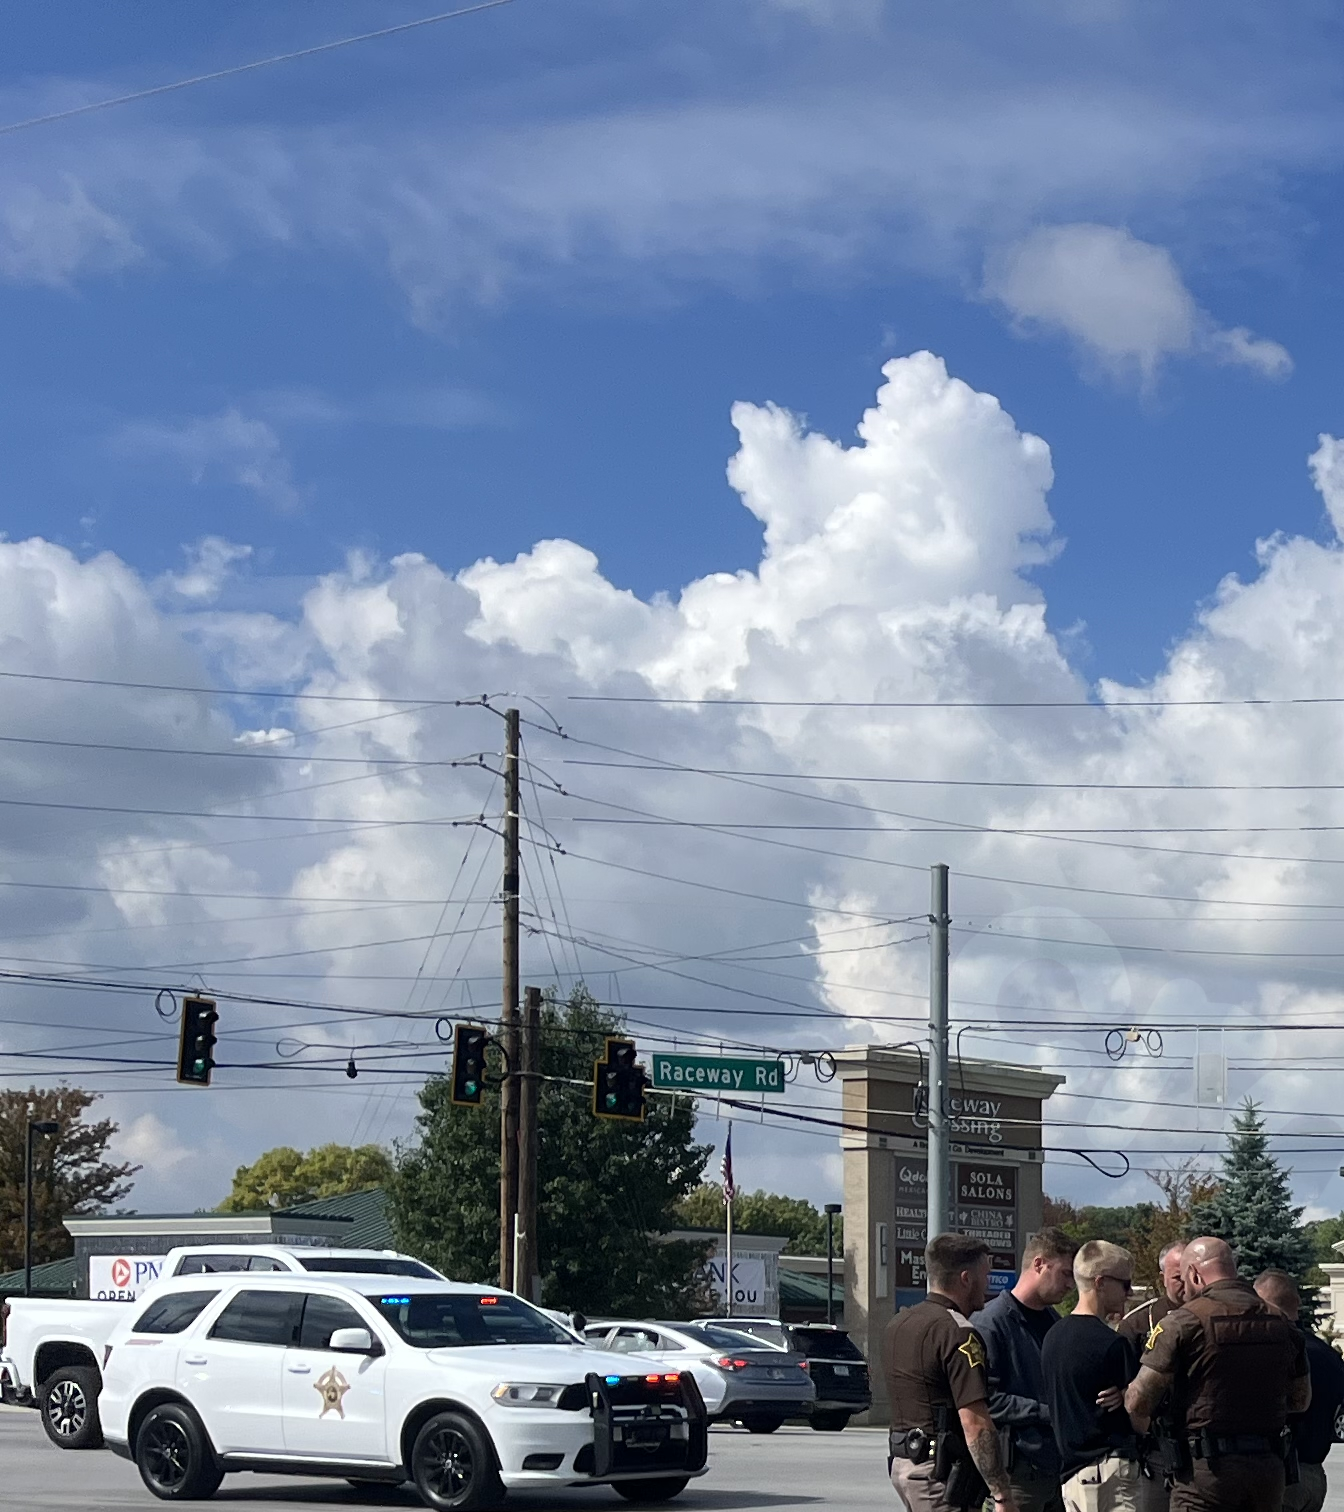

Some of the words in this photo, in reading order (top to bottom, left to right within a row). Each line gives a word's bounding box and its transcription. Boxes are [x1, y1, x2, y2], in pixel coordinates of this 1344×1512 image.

[660, 1061, 743, 1088] Raceway
[755, 1067, 778, 1086] Rd
[970, 1171, 1003, 1186] SOLA
[961, 1185, 1012, 1200] SALONS
[970, 1209, 1003, 1220] CHINA
